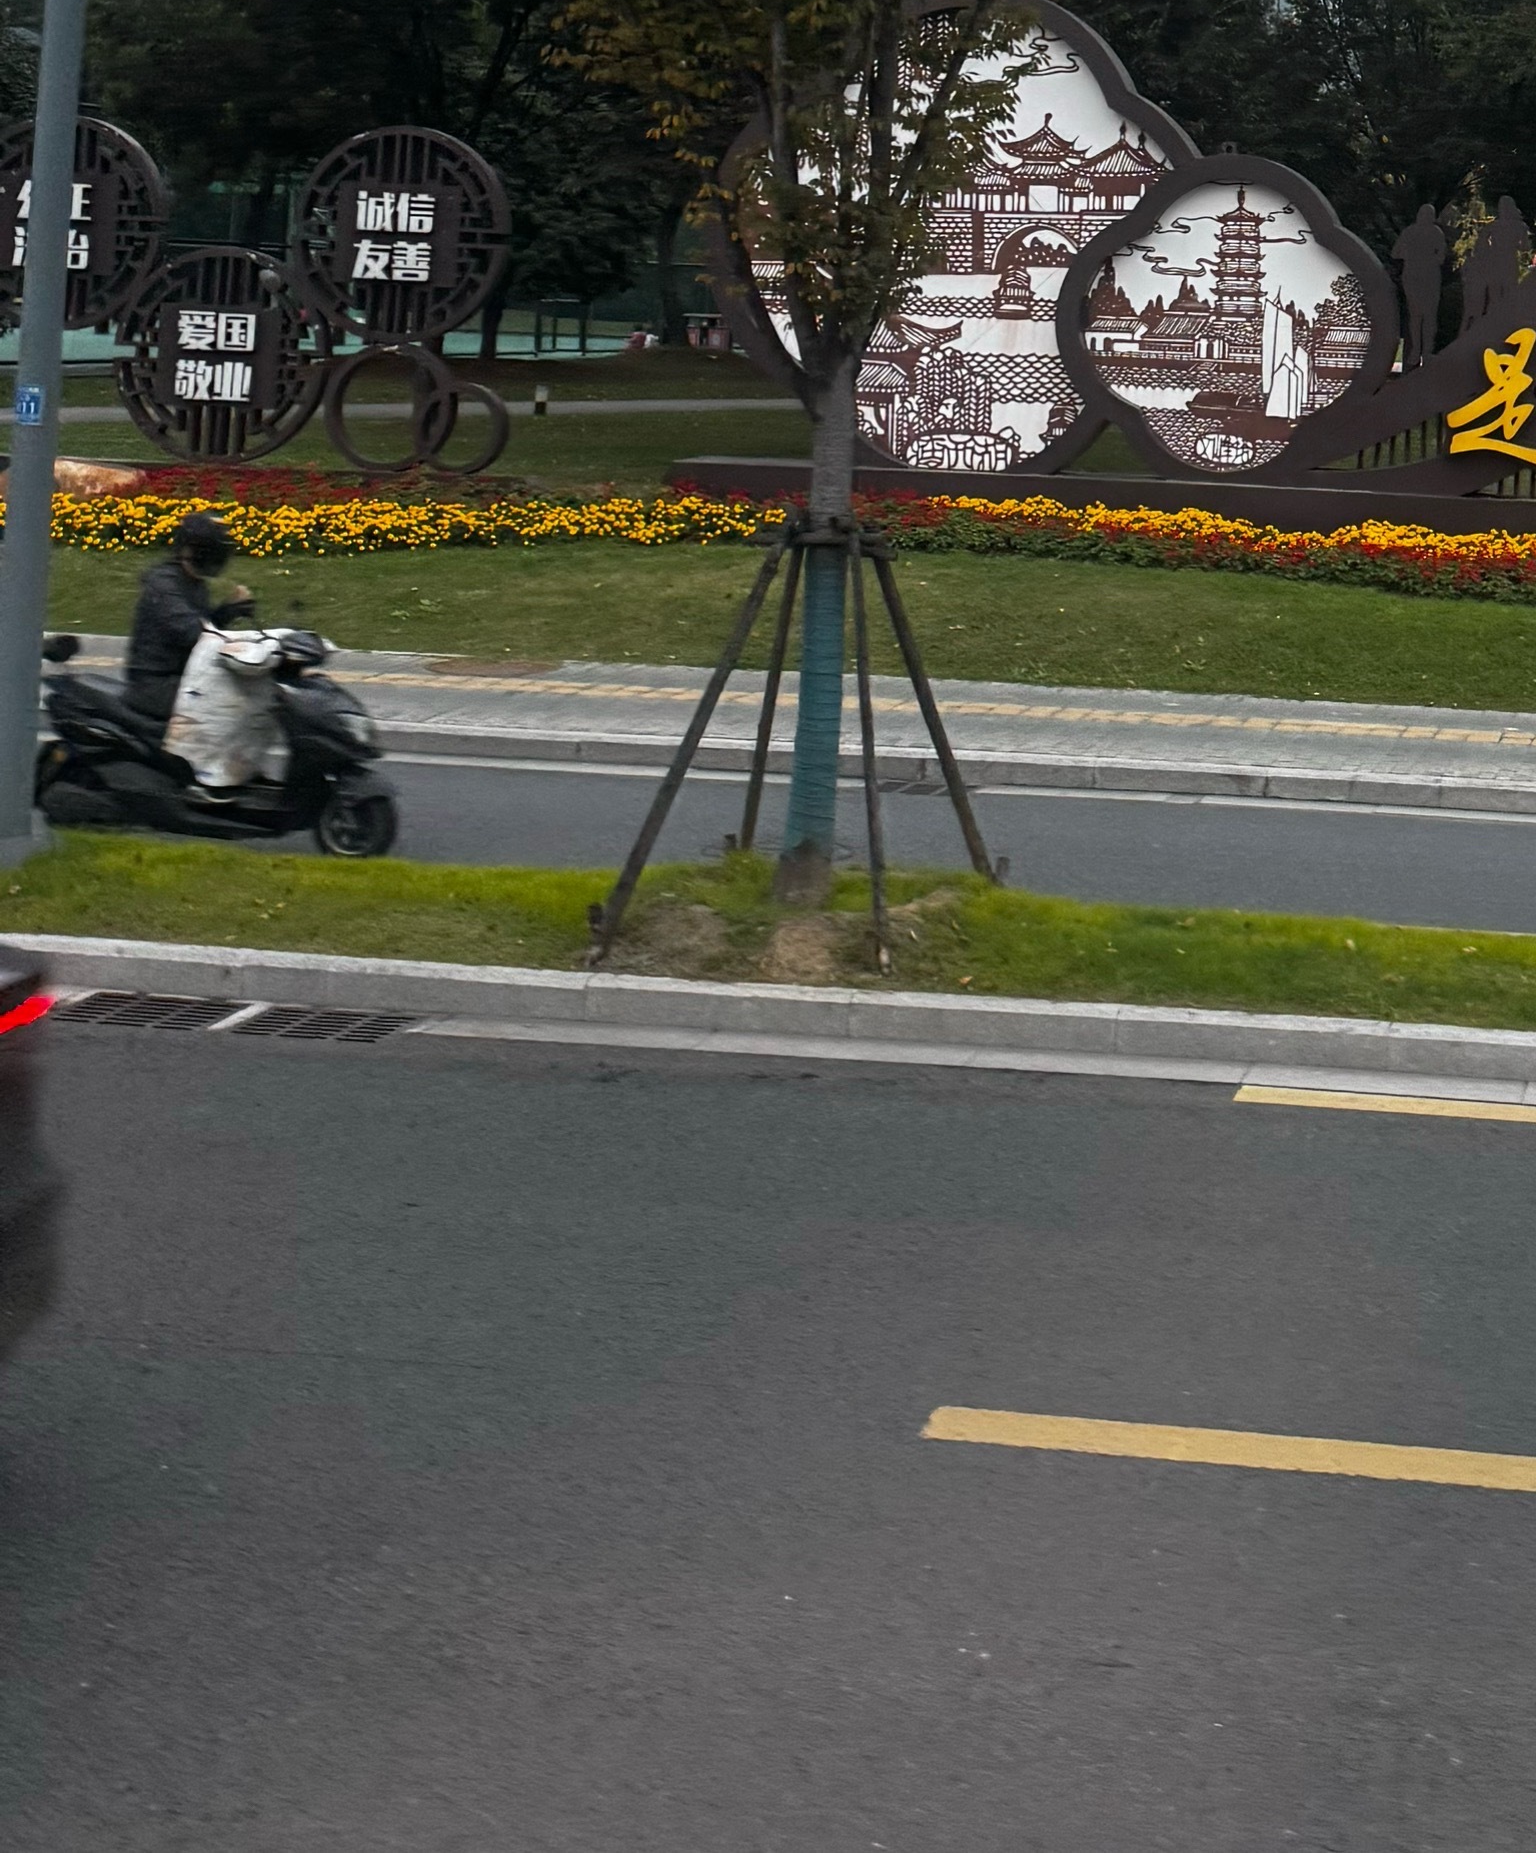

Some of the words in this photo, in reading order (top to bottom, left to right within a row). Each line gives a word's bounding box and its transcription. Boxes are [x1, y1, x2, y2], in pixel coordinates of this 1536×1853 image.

[356, 190, 436, 233] 诚信
[351, 239, 432, 282] 友善
[177, 310, 256, 352] 爱国
[174, 359, 252, 402] 敬业
